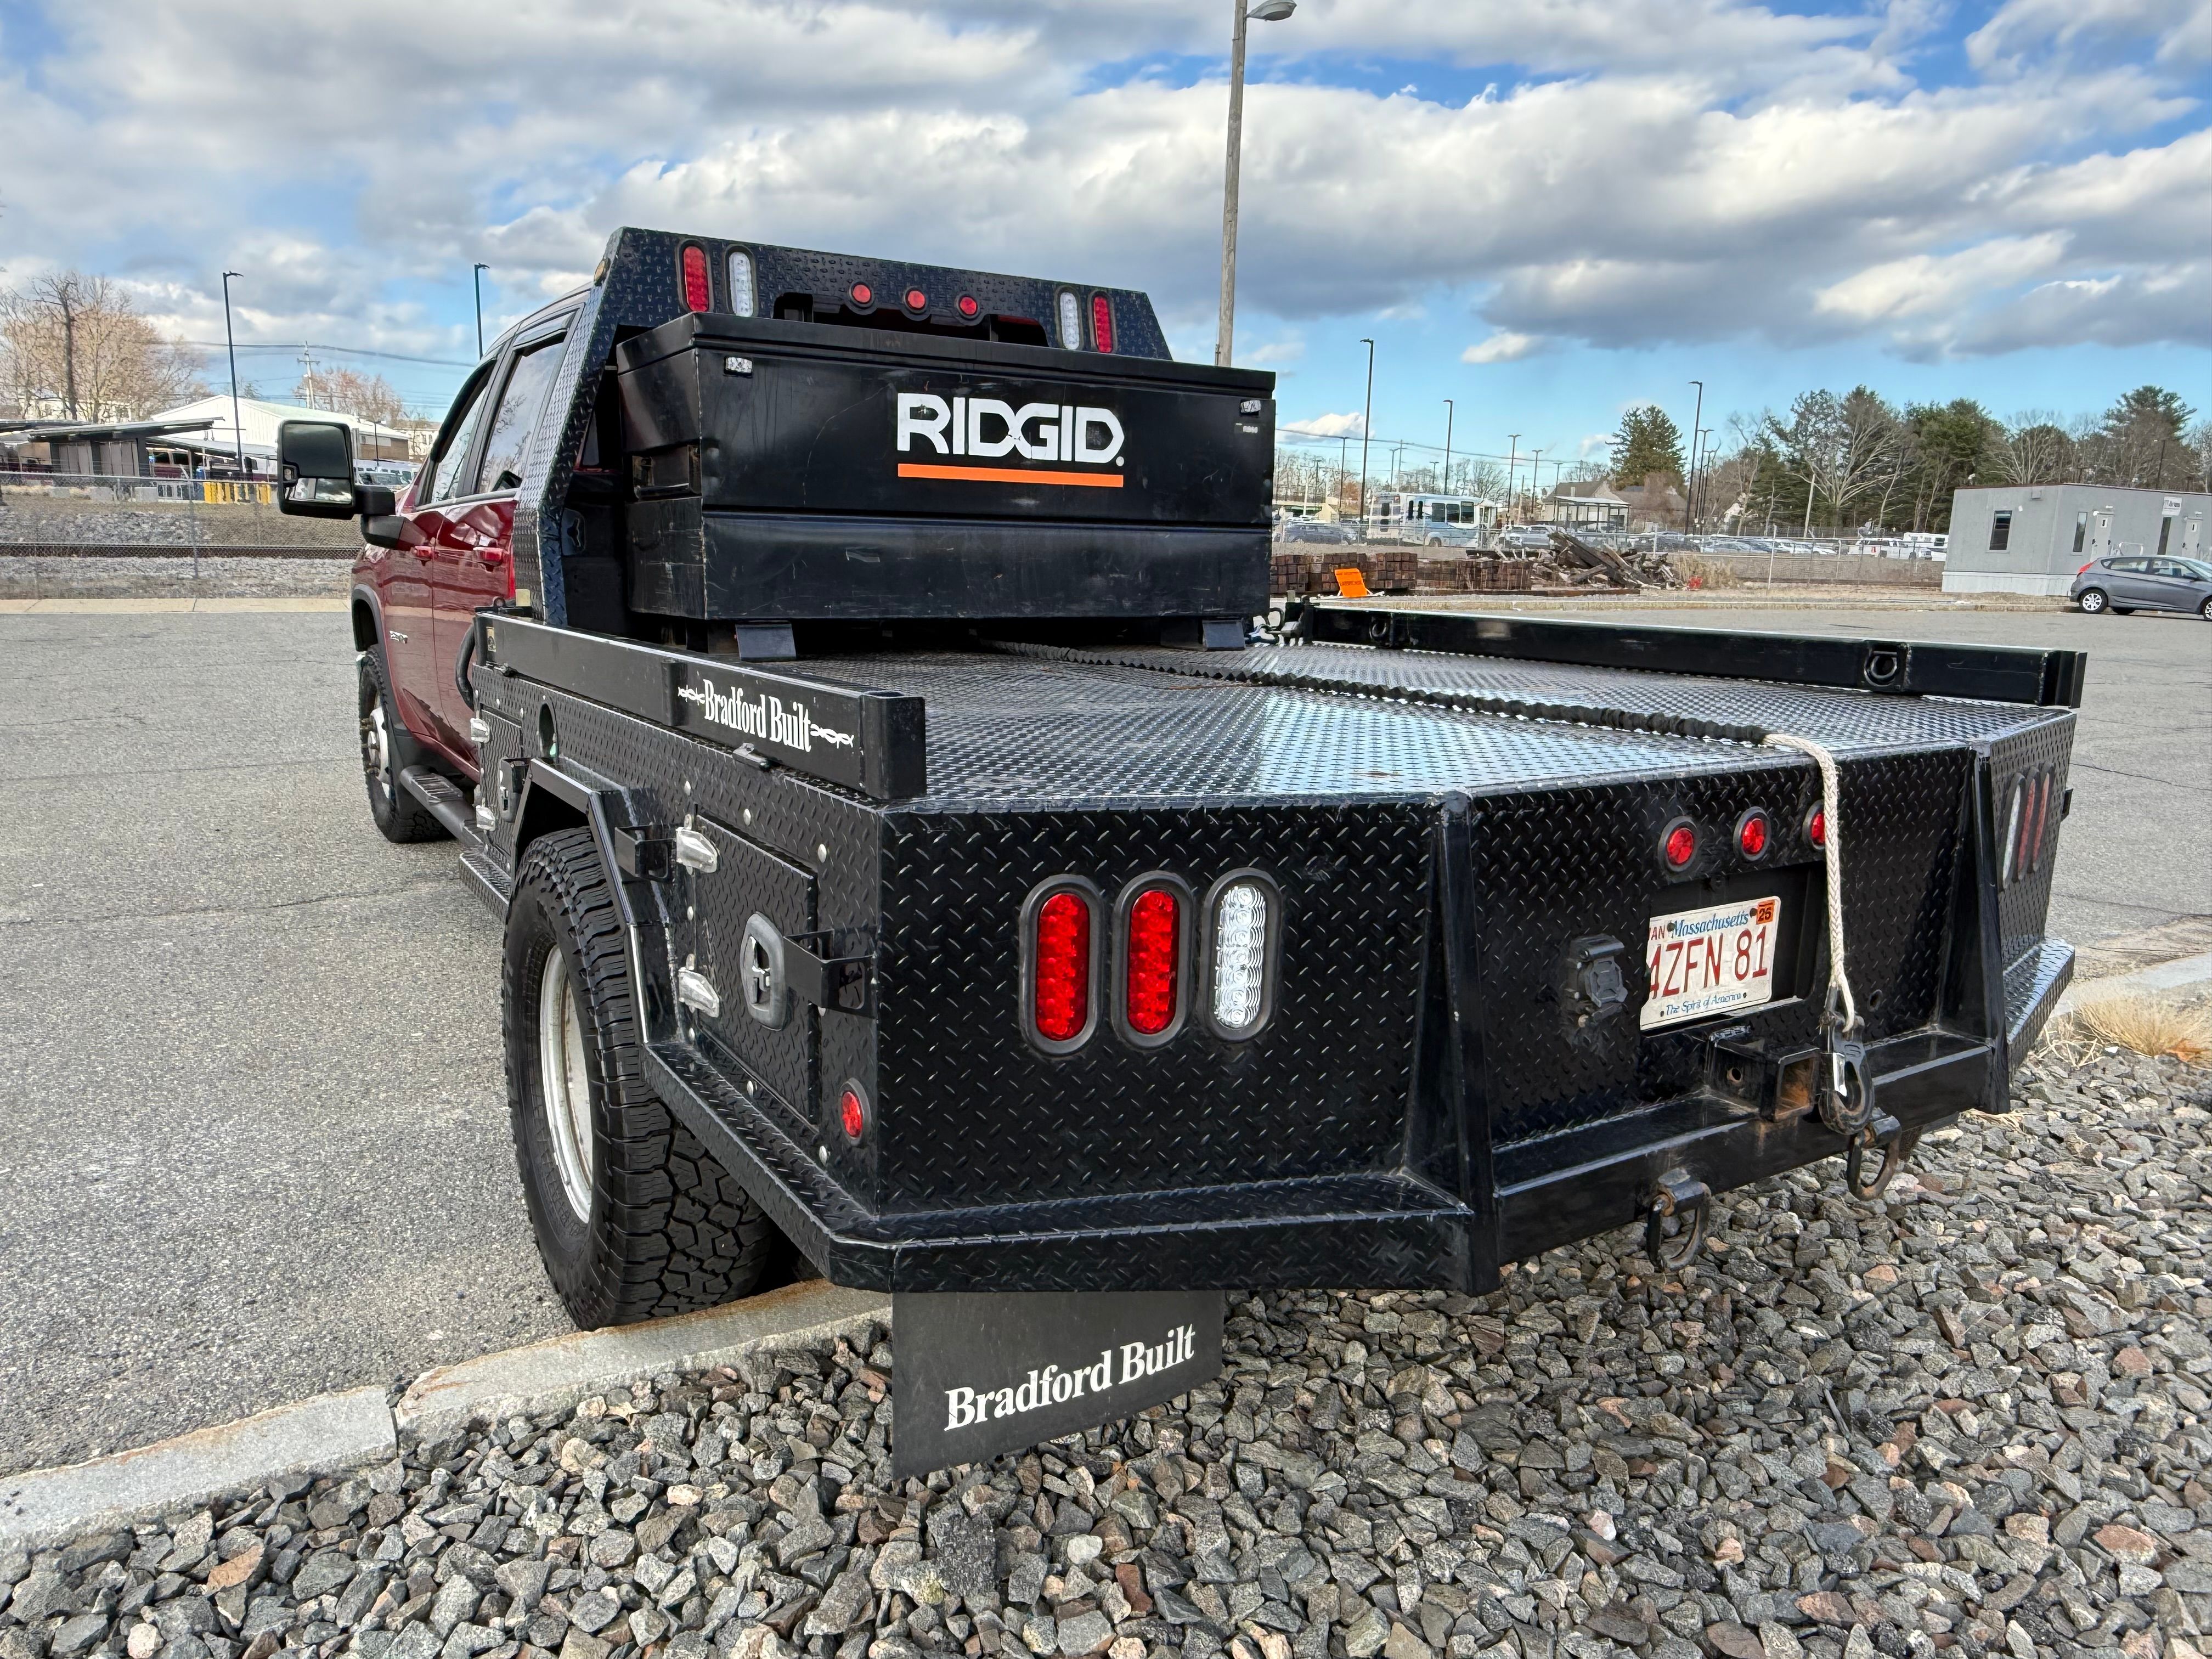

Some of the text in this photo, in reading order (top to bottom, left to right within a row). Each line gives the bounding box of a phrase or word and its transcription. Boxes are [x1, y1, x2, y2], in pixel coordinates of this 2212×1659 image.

[703, 679, 811, 753] Bradford Built
[1671, 911, 1749, 938] Massachusetts
[1734, 926, 1768, 981] 81
[944, 1324, 1195, 1431] Bradford Built
